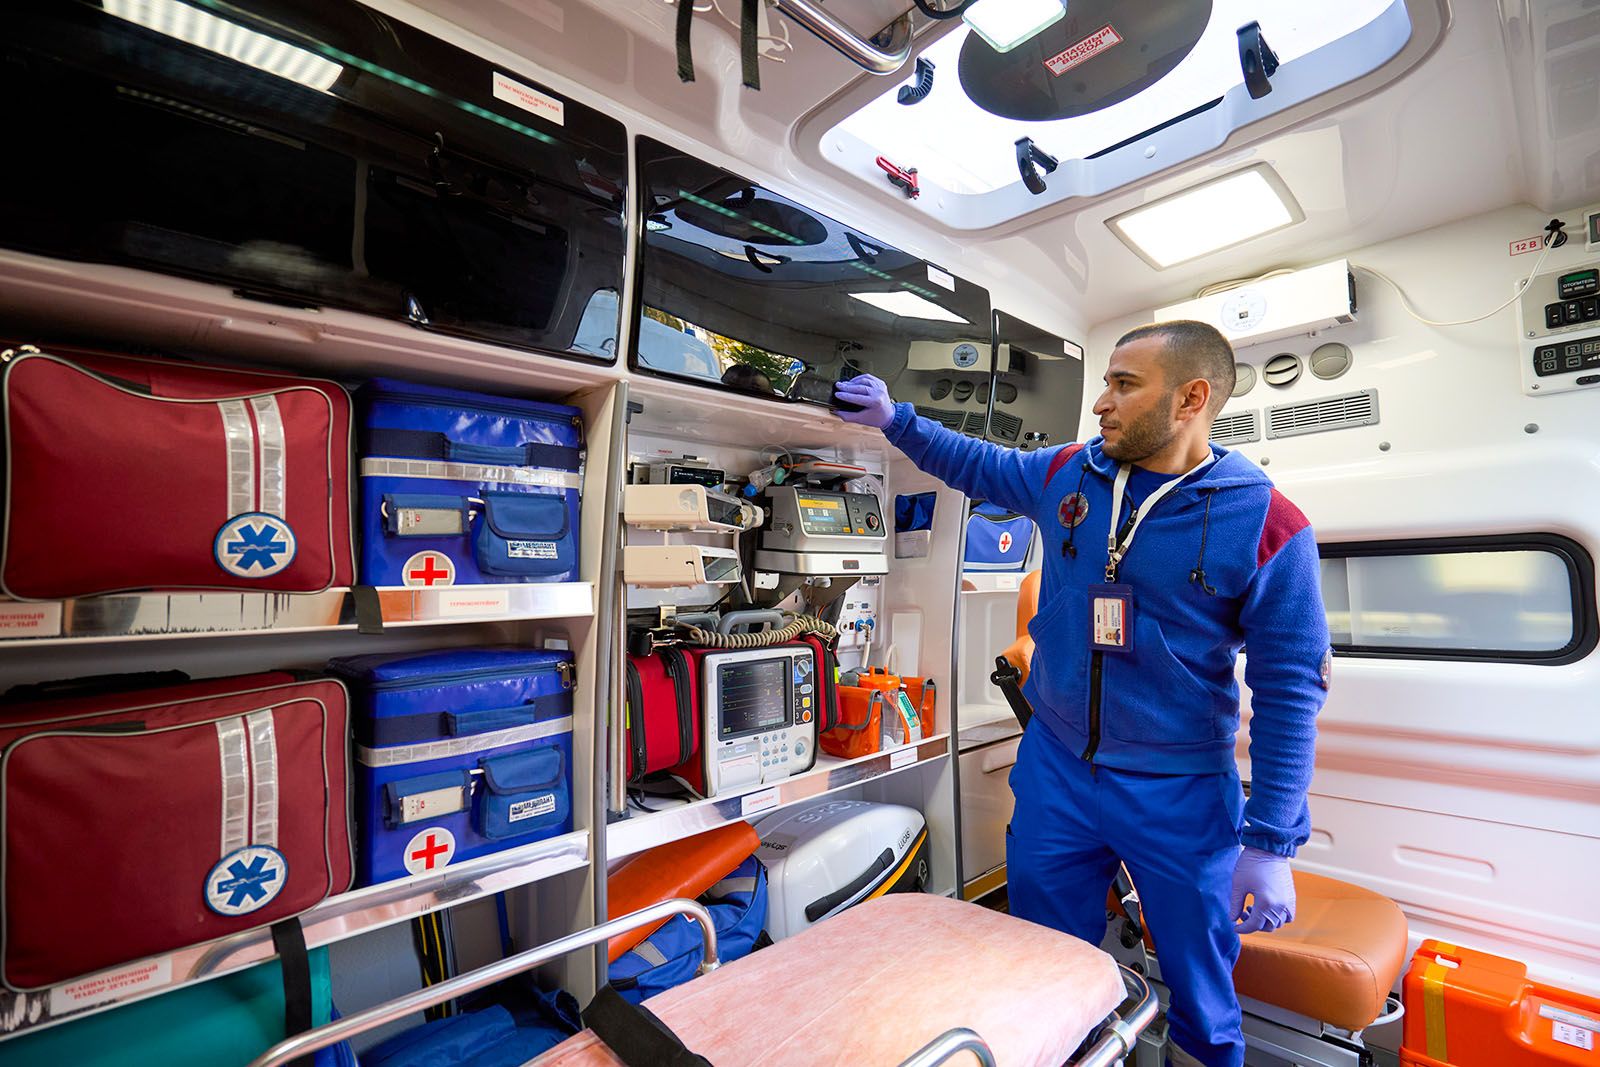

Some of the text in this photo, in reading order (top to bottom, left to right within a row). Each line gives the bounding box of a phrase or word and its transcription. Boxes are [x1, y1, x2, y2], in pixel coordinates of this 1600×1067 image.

[1048, 28, 1110, 67] ЗАПАСНЫЙ
[1062, 40, 1103, 65] ВЫХОД
[1515, 243, 1526, 251] 12
[1562, 278, 1596, 288] ОТОПИТЕЛЬ
[898, 830, 910, 850] LUCAS
[64, 963, 159, 995] РЕАНИМАЦИОННЫЙ
[74, 974, 150, 1000] НАБОР ДЕТСКИЙ
